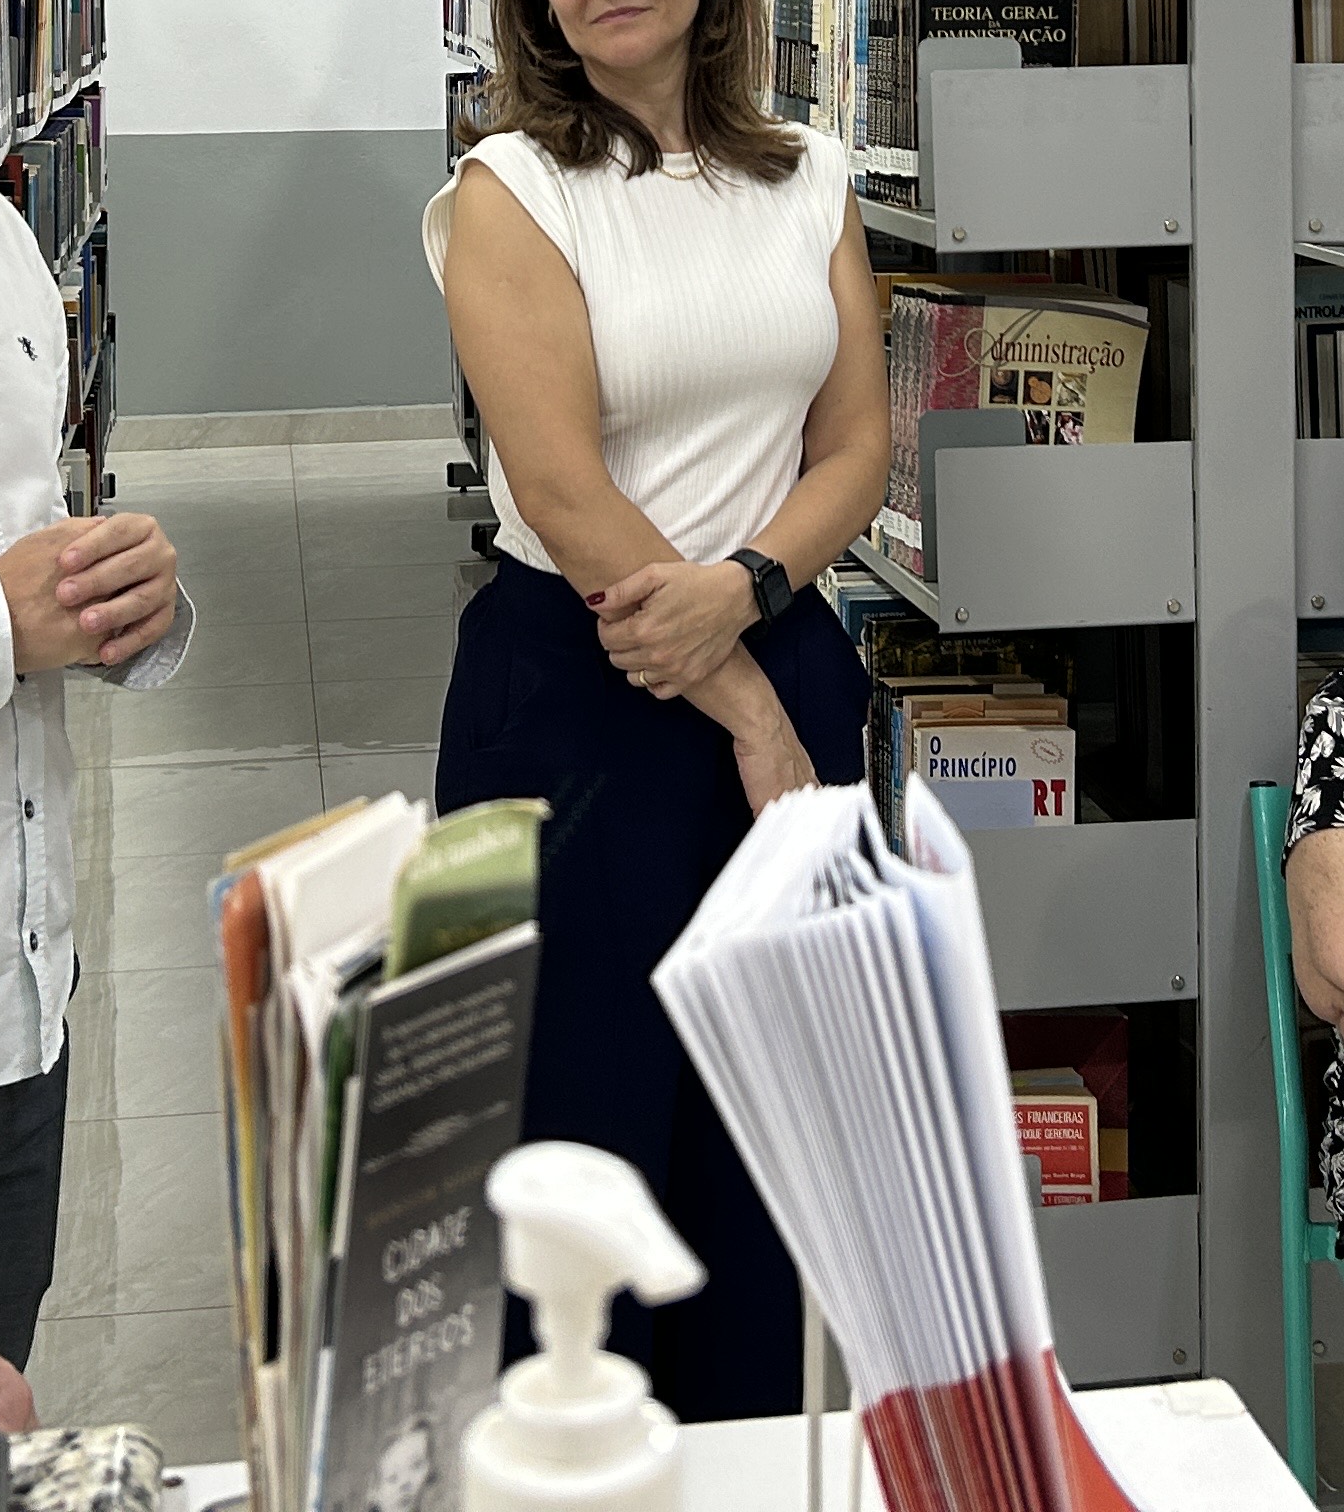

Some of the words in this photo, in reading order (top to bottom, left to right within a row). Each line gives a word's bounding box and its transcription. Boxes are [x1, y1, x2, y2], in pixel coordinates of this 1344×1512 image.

[931, 7, 993, 21] TEORIA
[1001, 6, 1059, 20] GERAL
[988, 20, 1001, 28] DA
[930, 736, 941, 755] O
[929, 751, 1017, 778] PRINCÍPIO
[1032, 779, 1066, 817] RT
[1027, 1111, 1084, 1124] FINANCEIRAS
[1044, 1127, 1084, 1140] GERENCIAL
